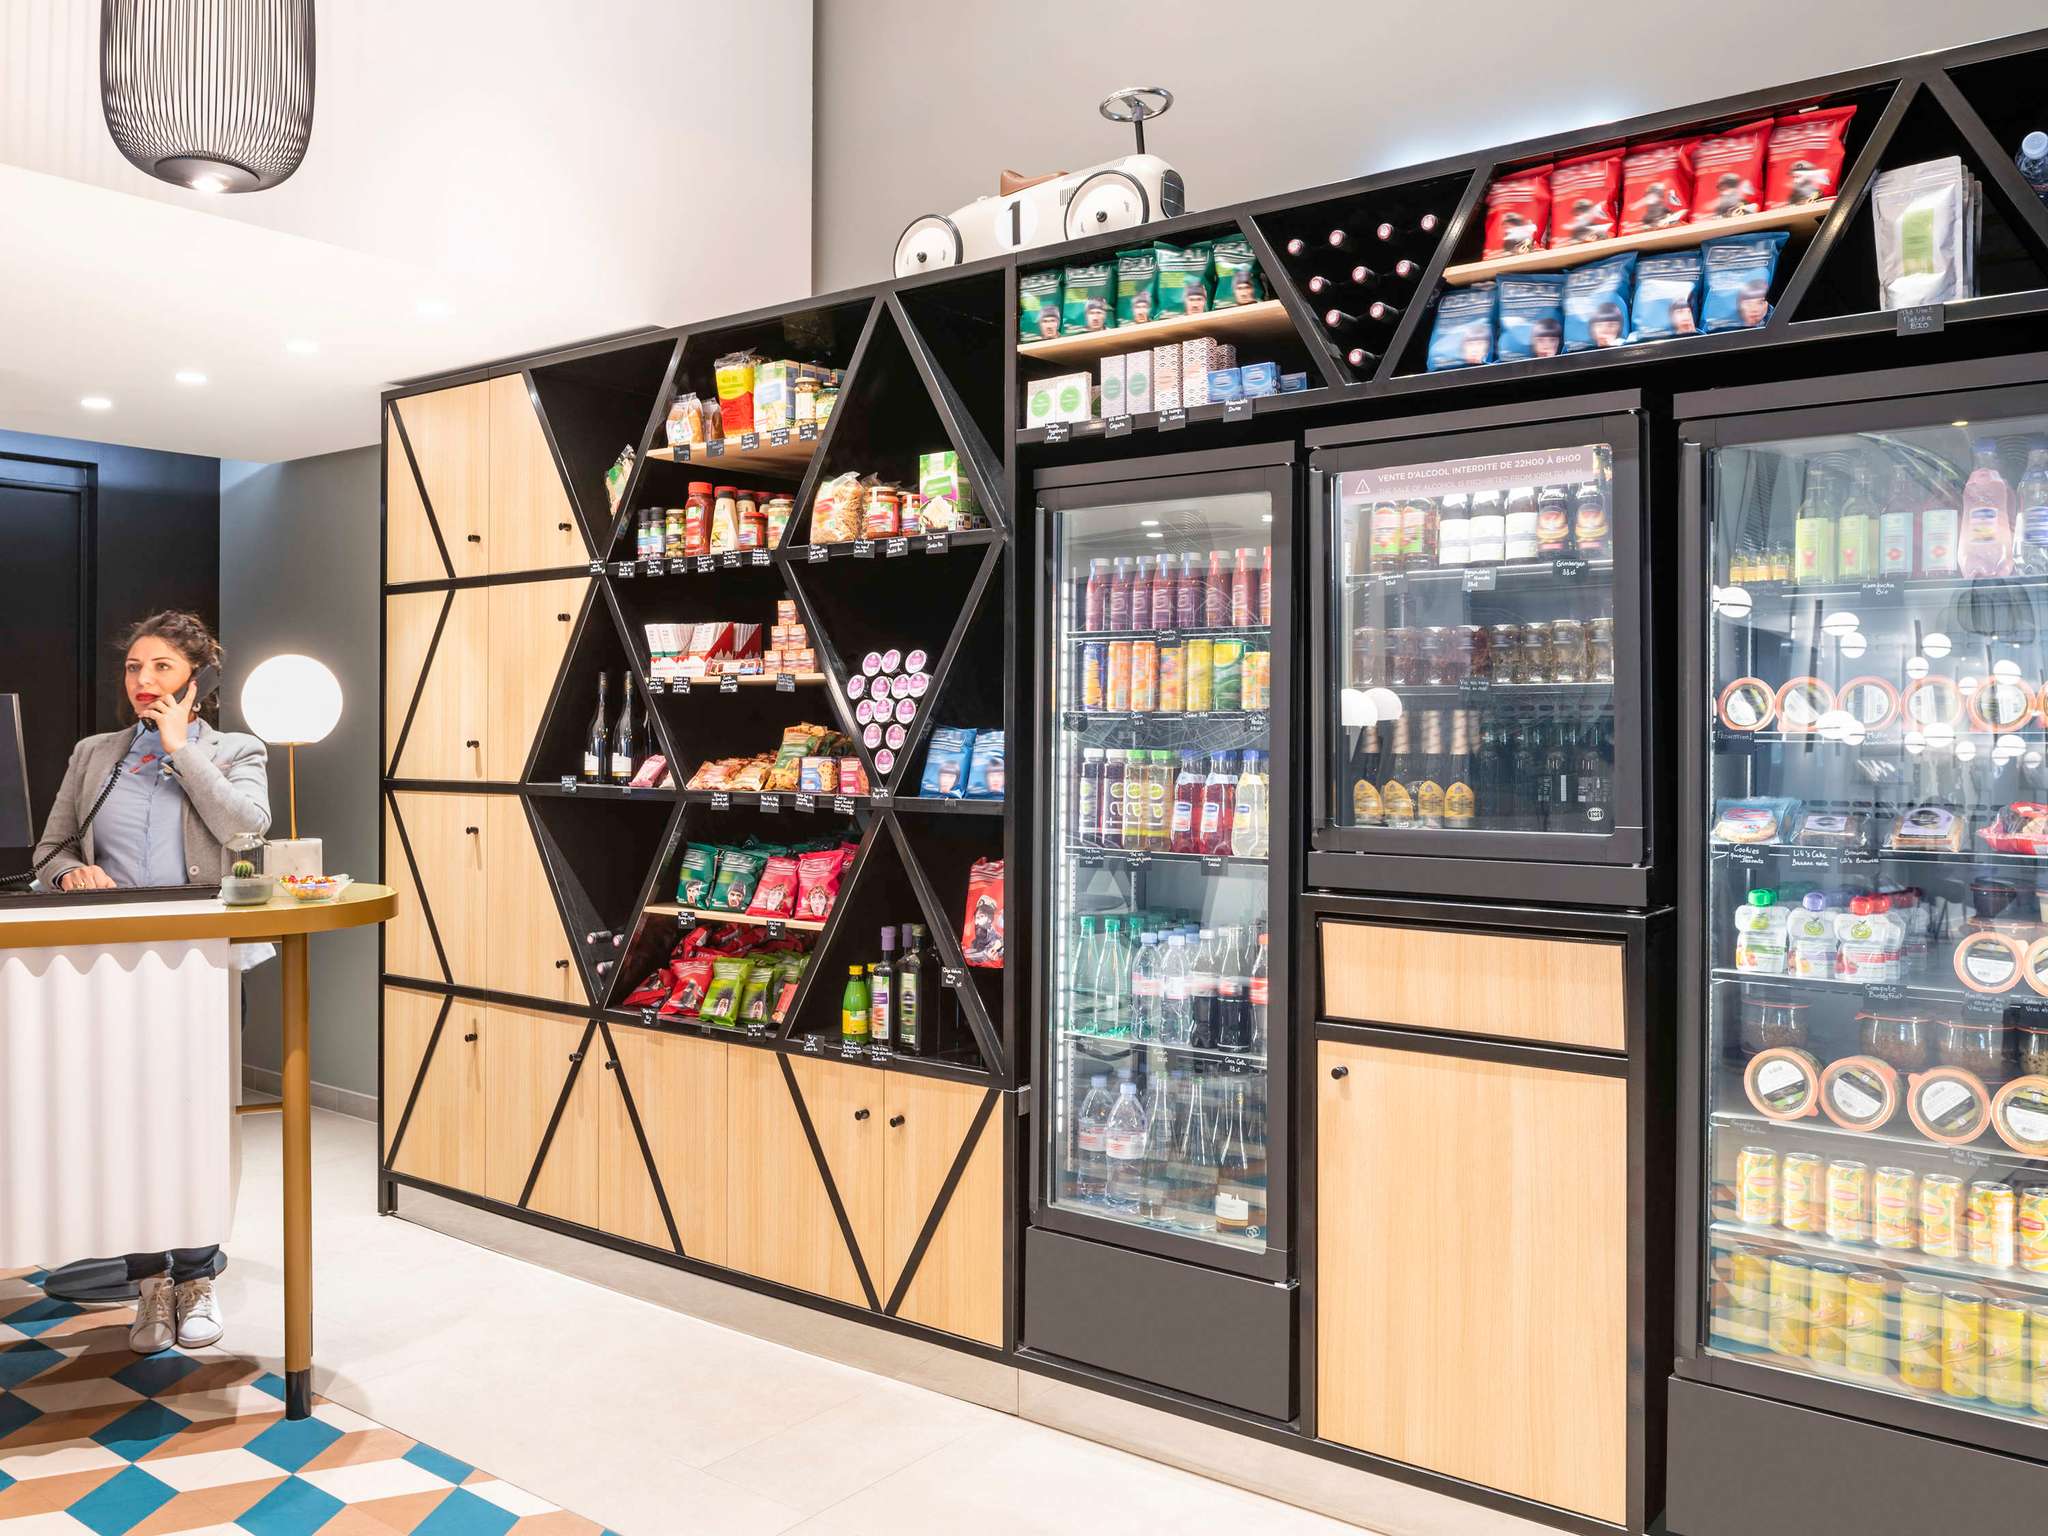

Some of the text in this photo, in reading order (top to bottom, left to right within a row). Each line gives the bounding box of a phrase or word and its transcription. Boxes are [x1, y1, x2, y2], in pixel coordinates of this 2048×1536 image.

[1007, 201, 1021, 246] 1
[1378, 472, 1405, 482] VENTE
[1407, 468, 1450, 480] D'ALCOOL
[1452, 463, 1498, 474] INTERDITE
[1500, 461, 1512, 470] DE
[1514, 457, 1545, 468] 22H00
[1546, 454, 1554, 464] À
[1734, 844, 1760, 854] Cookies
